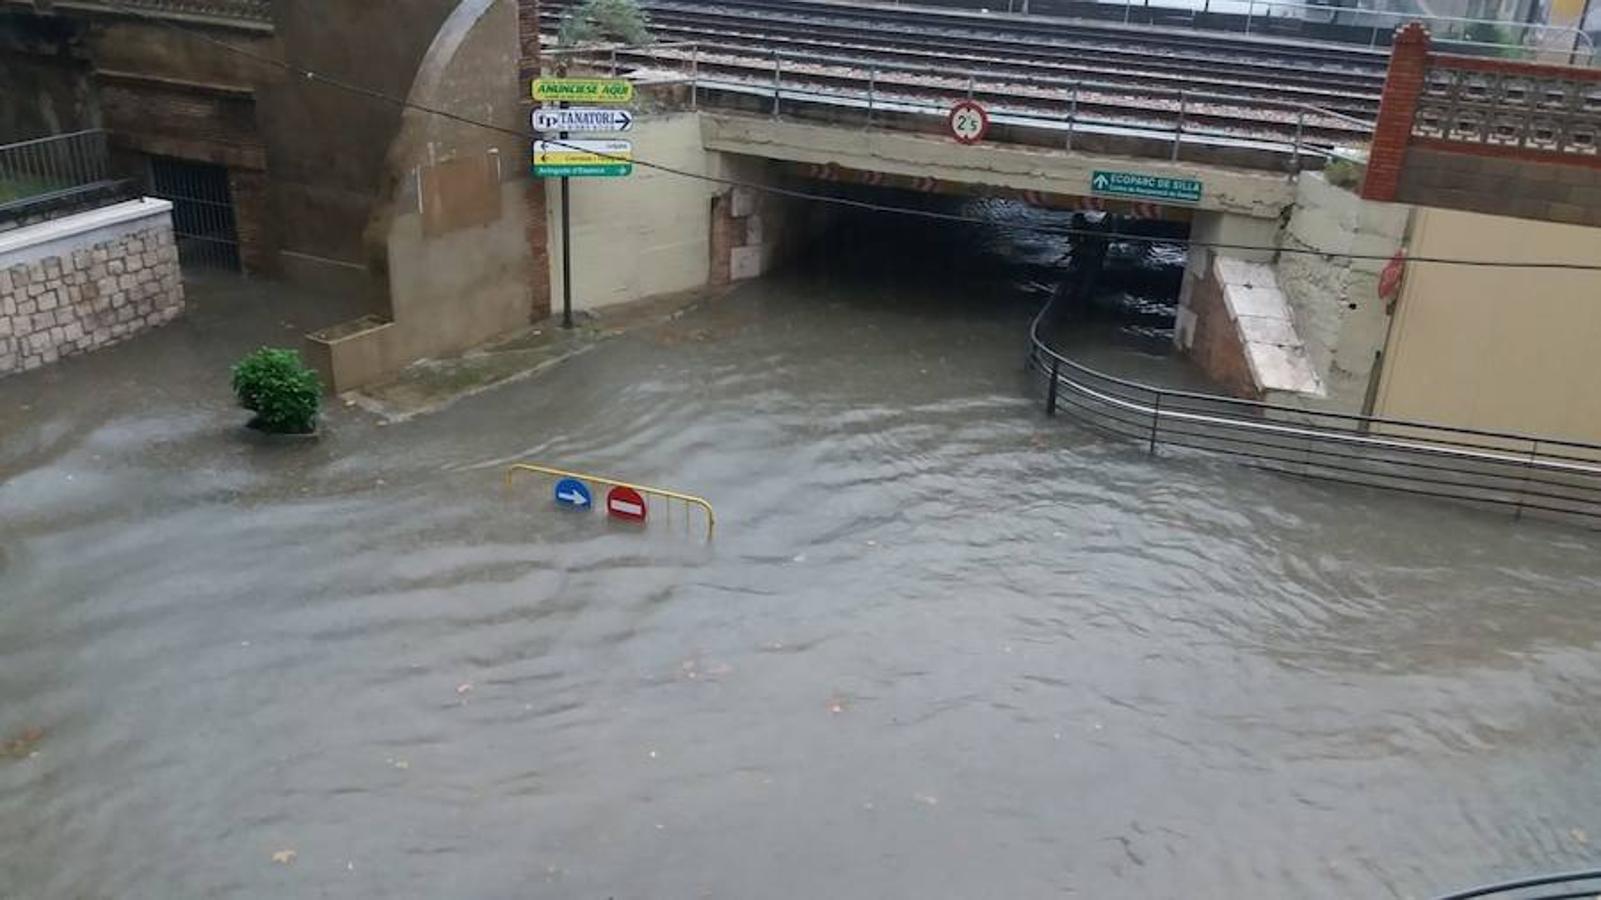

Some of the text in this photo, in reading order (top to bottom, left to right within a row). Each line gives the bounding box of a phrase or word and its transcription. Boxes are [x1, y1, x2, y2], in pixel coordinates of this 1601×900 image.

[560, 112, 614, 124] TANATORI
[1111, 174, 1200, 191] ECOPARC DE SILLA
